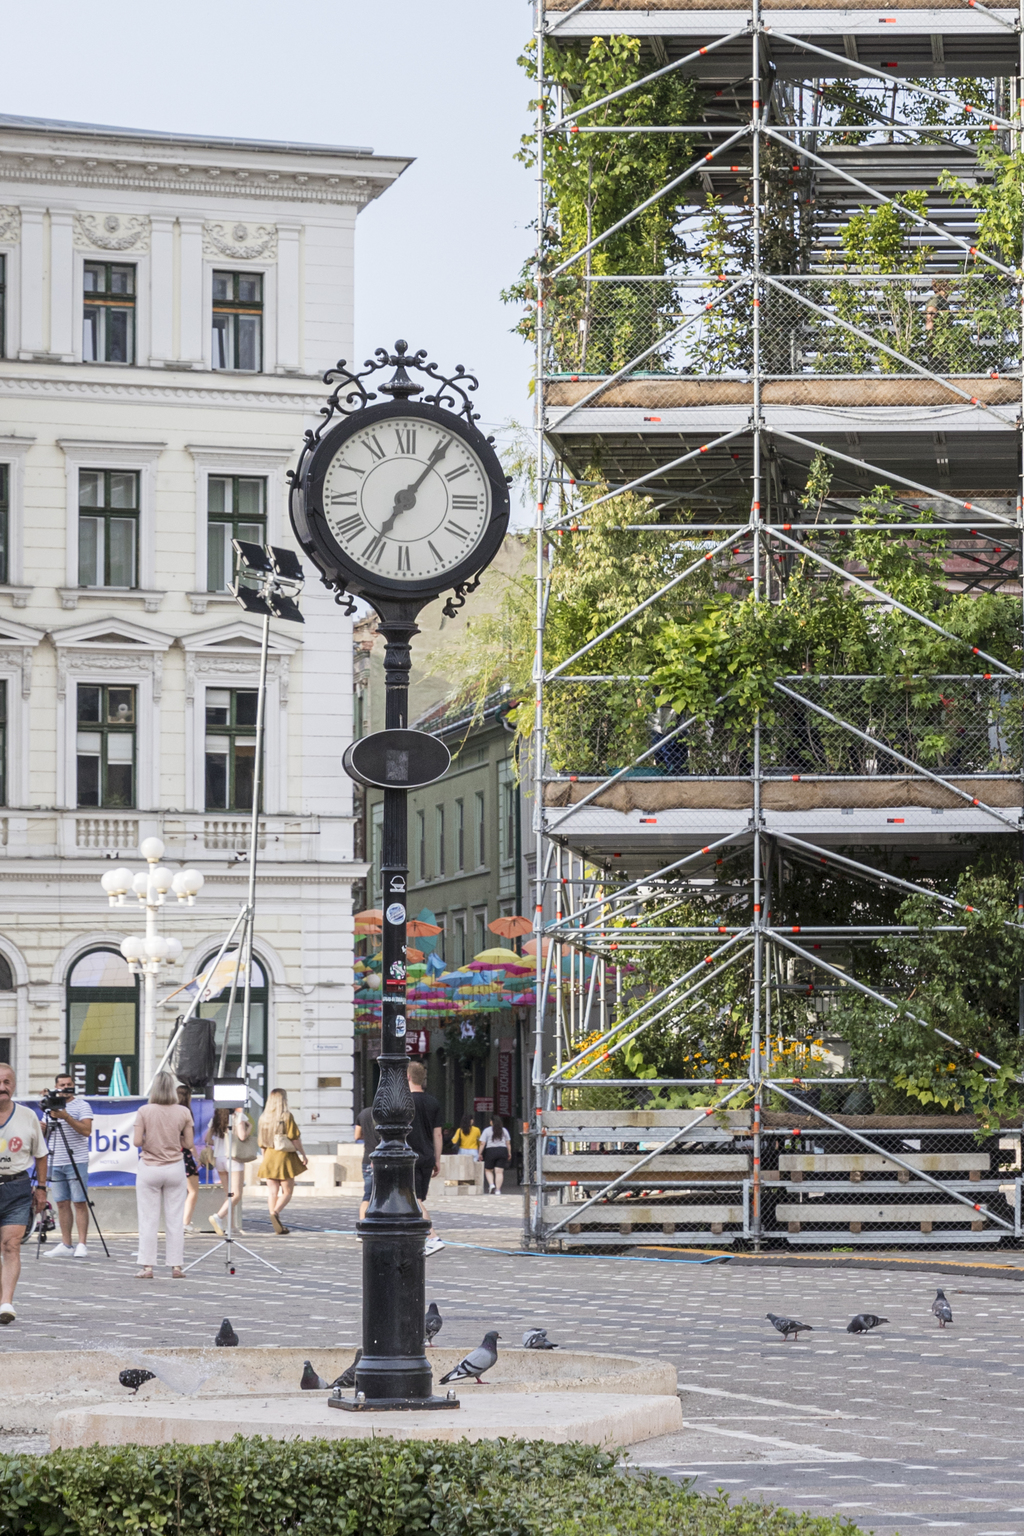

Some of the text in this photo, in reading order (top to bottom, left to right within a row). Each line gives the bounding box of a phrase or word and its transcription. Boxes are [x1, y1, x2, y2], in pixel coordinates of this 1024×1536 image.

[361, 434, 386, 463] XI
[394, 428, 416, 454] XII
[338, 458, 366, 480] X
[444, 463, 470, 483] II
[331, 488, 357, 506] IX
[452, 494, 478, 510] III
[335, 512, 367, 544] VIII
[444, 519, 471, 544] IV
[360, 534, 387, 565] VII
[397, 545, 411, 571] VI
[427, 539, 444, 565] V
[499, 1054, 509, 1093] EXCHANGE
